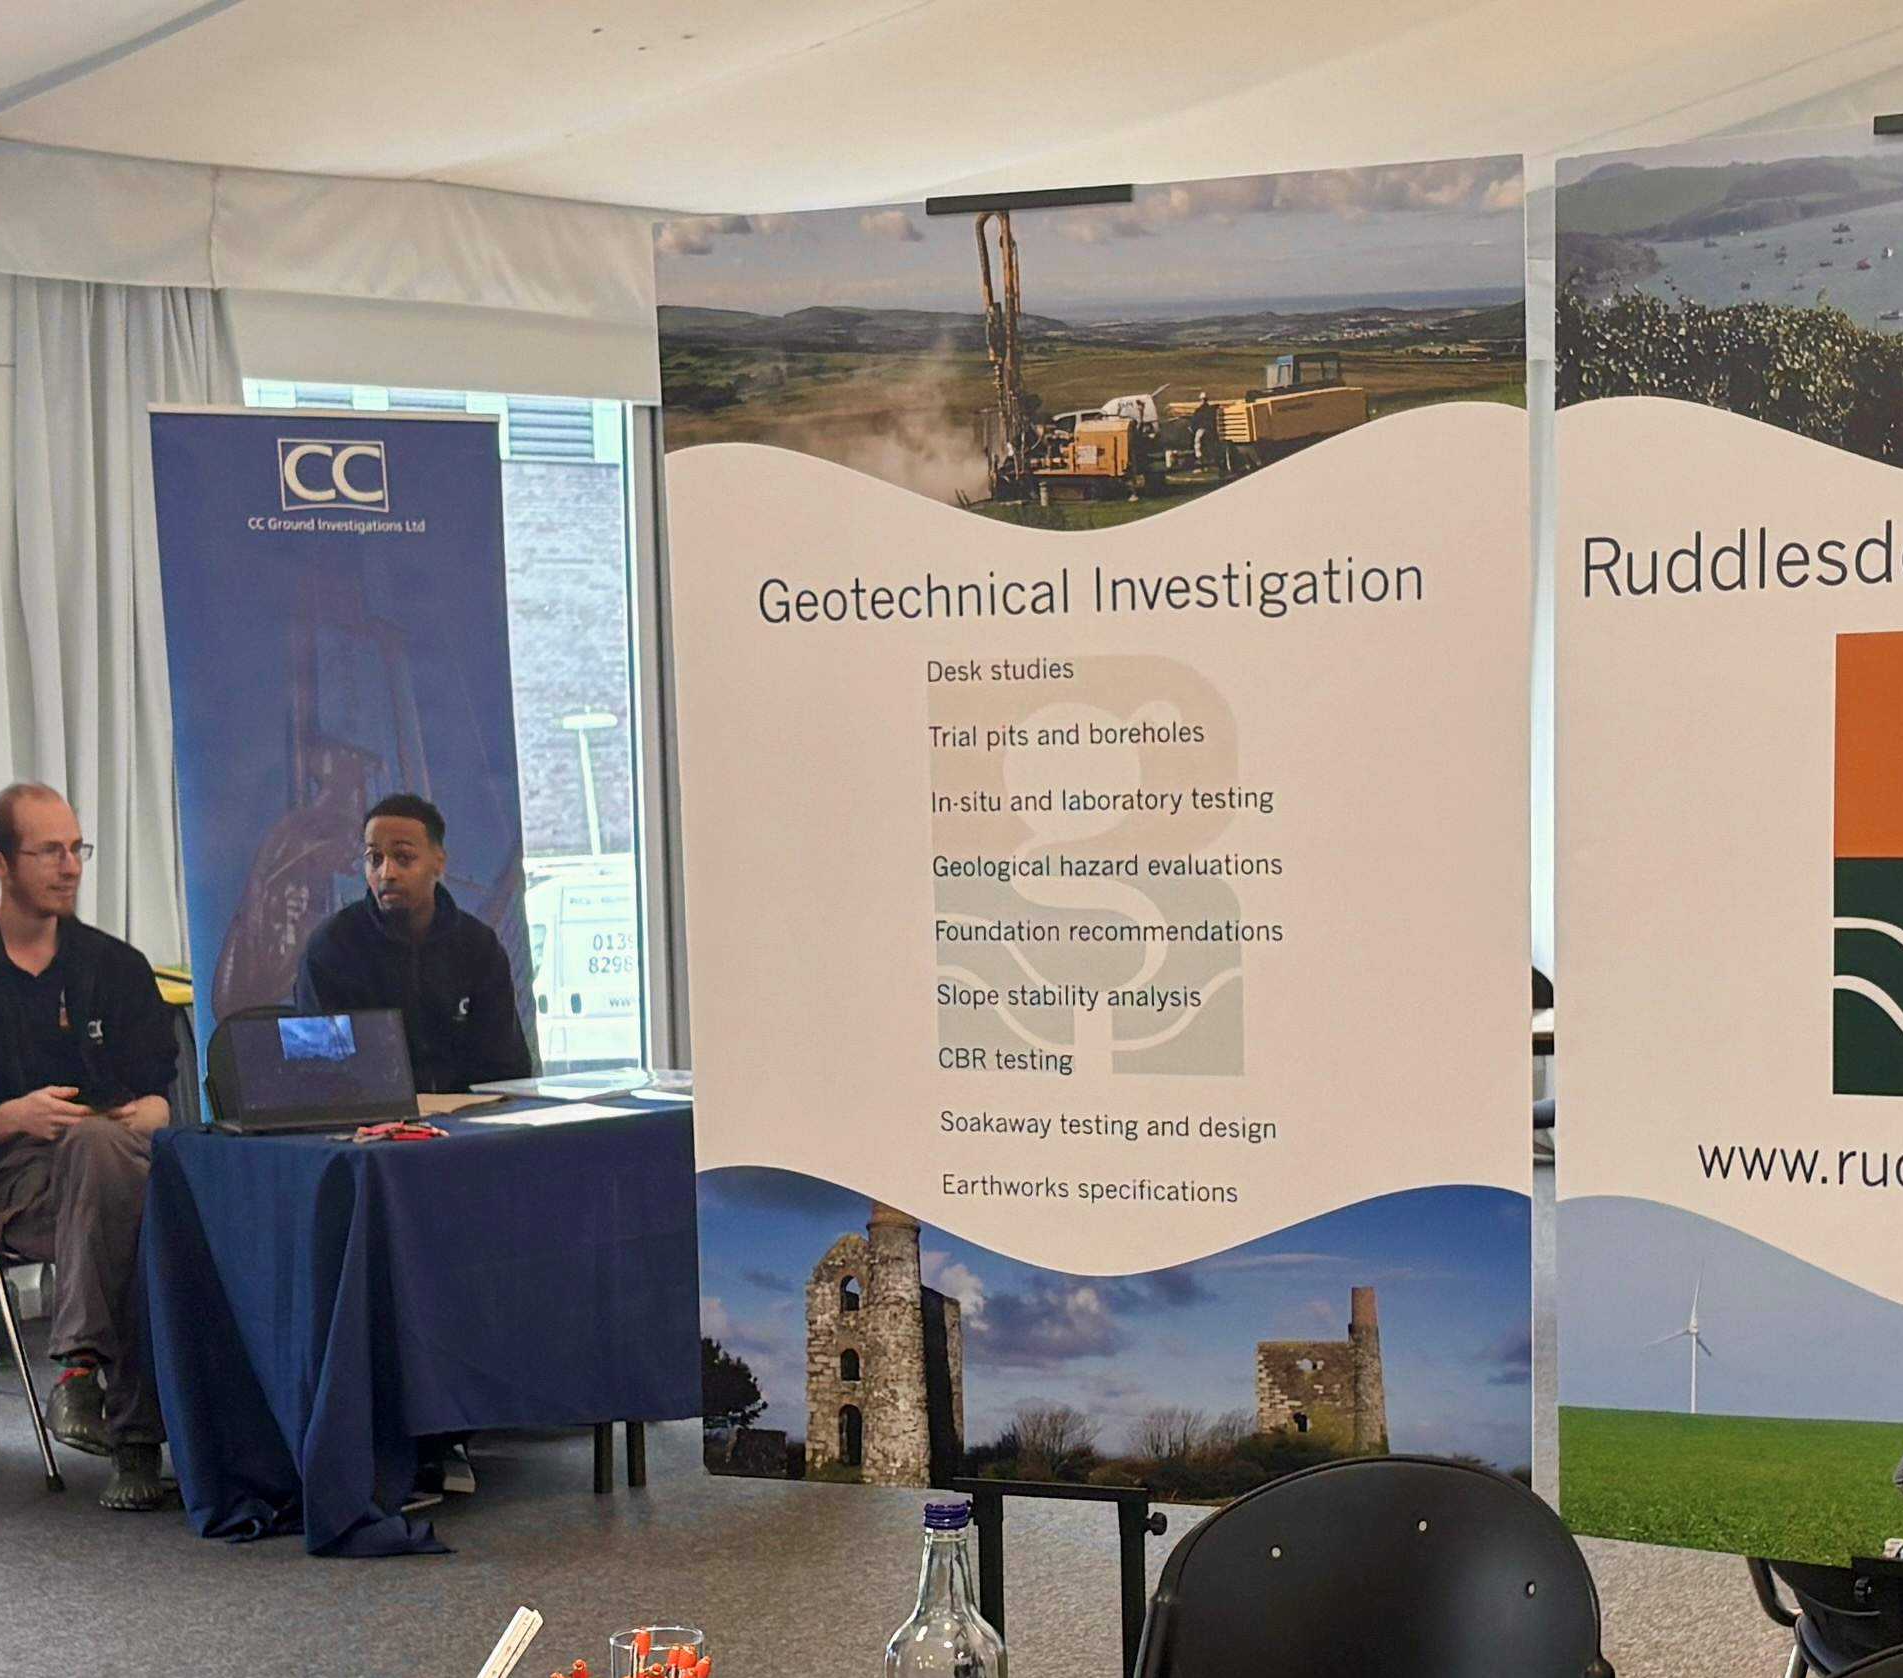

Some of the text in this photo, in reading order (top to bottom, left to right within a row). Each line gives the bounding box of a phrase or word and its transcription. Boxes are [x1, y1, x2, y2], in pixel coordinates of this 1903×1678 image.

[284, 444, 384, 502] CC
[248, 517, 426, 535] CC Ground Investigations Ltd
[760, 557, 1423, 624] Geotechnical Investigation
[929, 658, 1075, 683] Desk studies
[929, 722, 1205, 752] Trial pits and boreholes
[933, 788, 1274, 816] In-situ and laboratory testing
[934, 855, 1283, 883] Geological hazard evaluations
[937, 921, 1284, 943] Foundation recommendations
[938, 985, 1206, 1013] Slope stability analysis
[940, 1048, 1075, 1077] CBR testing
[942, 1111, 1277, 1145] Soakaway testing and design
[944, 1175, 1238, 1204] Earthworks specifications
